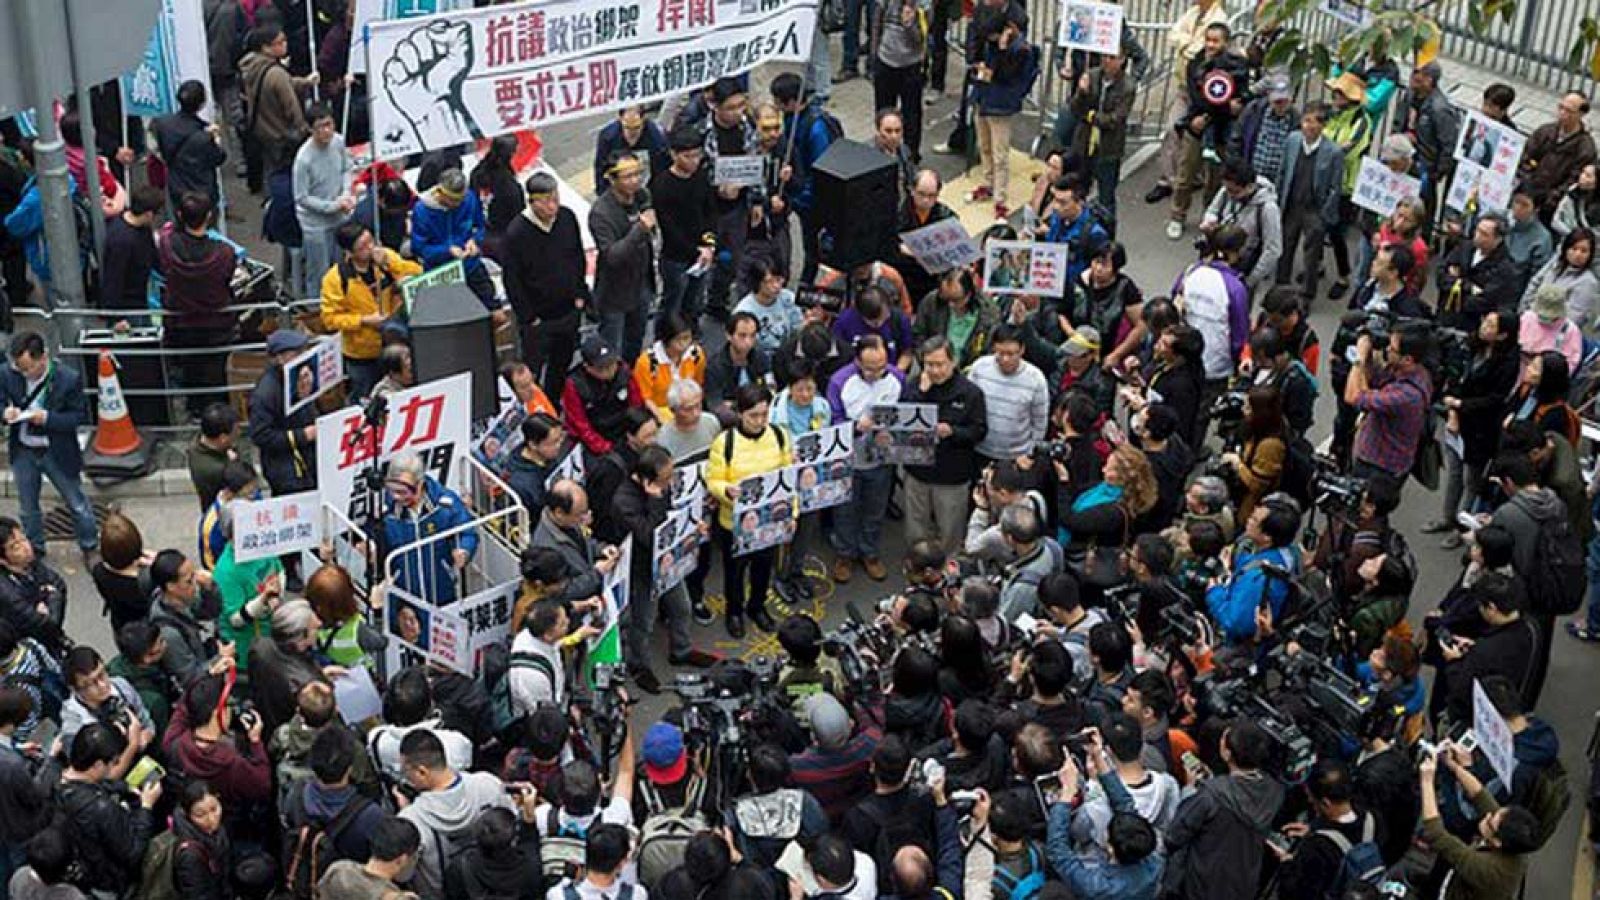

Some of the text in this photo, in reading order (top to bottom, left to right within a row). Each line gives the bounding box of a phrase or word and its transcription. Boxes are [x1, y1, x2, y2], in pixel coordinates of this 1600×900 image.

[486, 4, 640, 67] 抗議政治綁架
[338, 394, 445, 470] 強力
[869, 406, 932, 429] 尋人
[796, 427, 850, 463] 尋人
[738, 469, 792, 504] 尋人
[657, 504, 699, 550] 尋人
